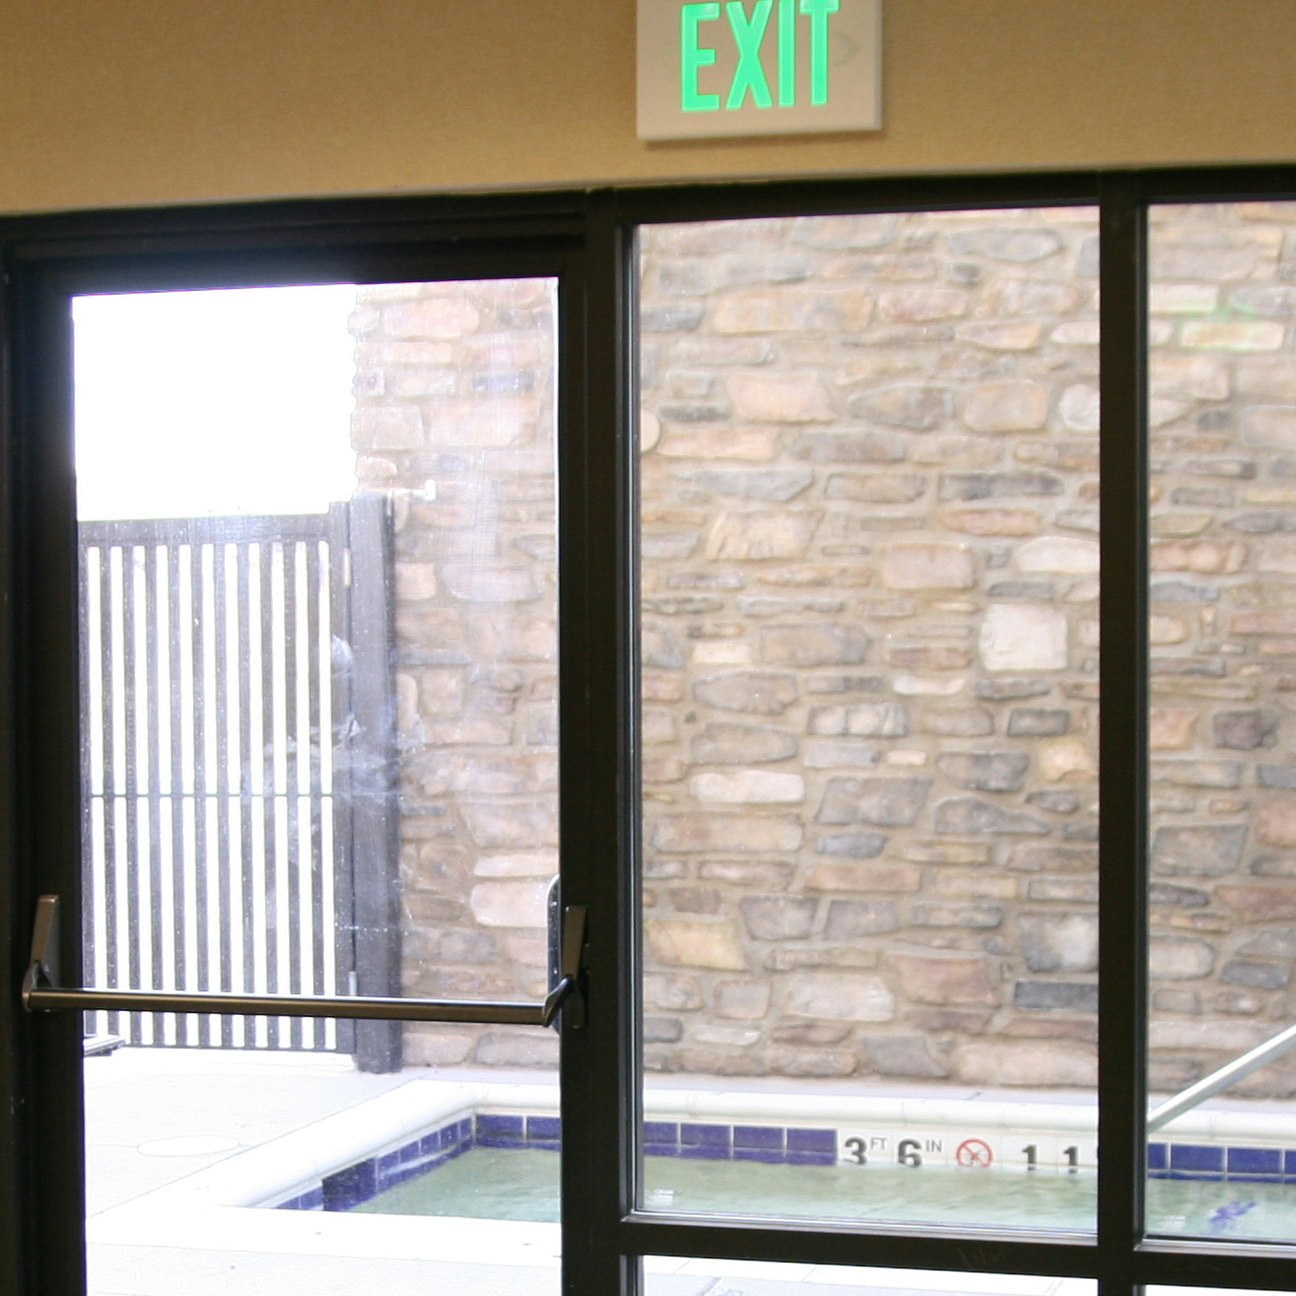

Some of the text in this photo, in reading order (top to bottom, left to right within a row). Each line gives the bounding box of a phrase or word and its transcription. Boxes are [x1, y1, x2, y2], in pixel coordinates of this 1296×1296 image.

[681, 0, 840, 112] EXIT
[844, 1137, 868, 1165] 3
[870, 1137, 888, 1151] FT
[897, 1138, 923, 1168] 6
[925, 1139, 943, 1153] IN
